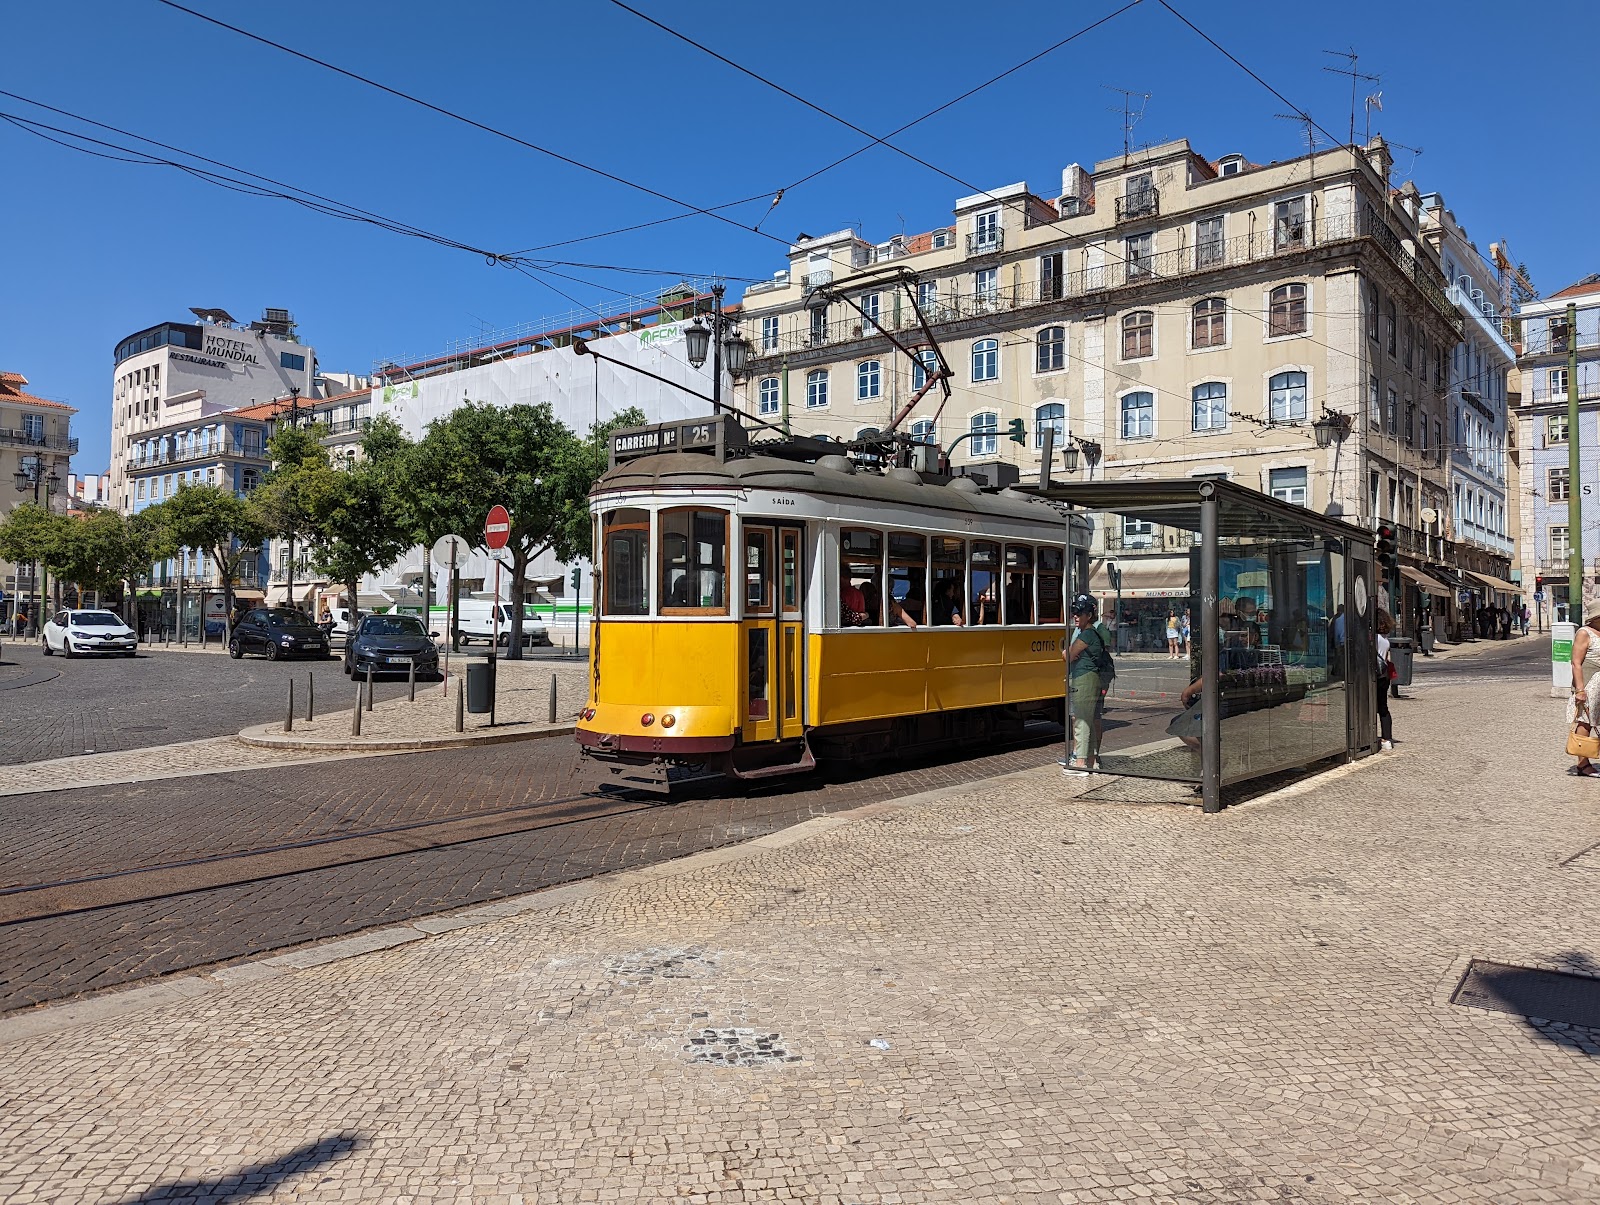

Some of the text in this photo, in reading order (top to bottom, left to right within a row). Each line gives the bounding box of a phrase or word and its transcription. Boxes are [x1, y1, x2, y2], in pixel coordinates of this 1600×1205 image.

[652, 327, 678, 342] FCM
[206, 335, 246, 352] HOTEL
[169, 352, 227, 369] RESTAURANTE
[206, 346, 259, 364] MUNDIAL
[616, 433, 659, 451] CARREIRA
[692, 426, 710, 444] 25
[772, 496, 795, 506] SAÍDA
[1031, 636, 1055, 652] carris
